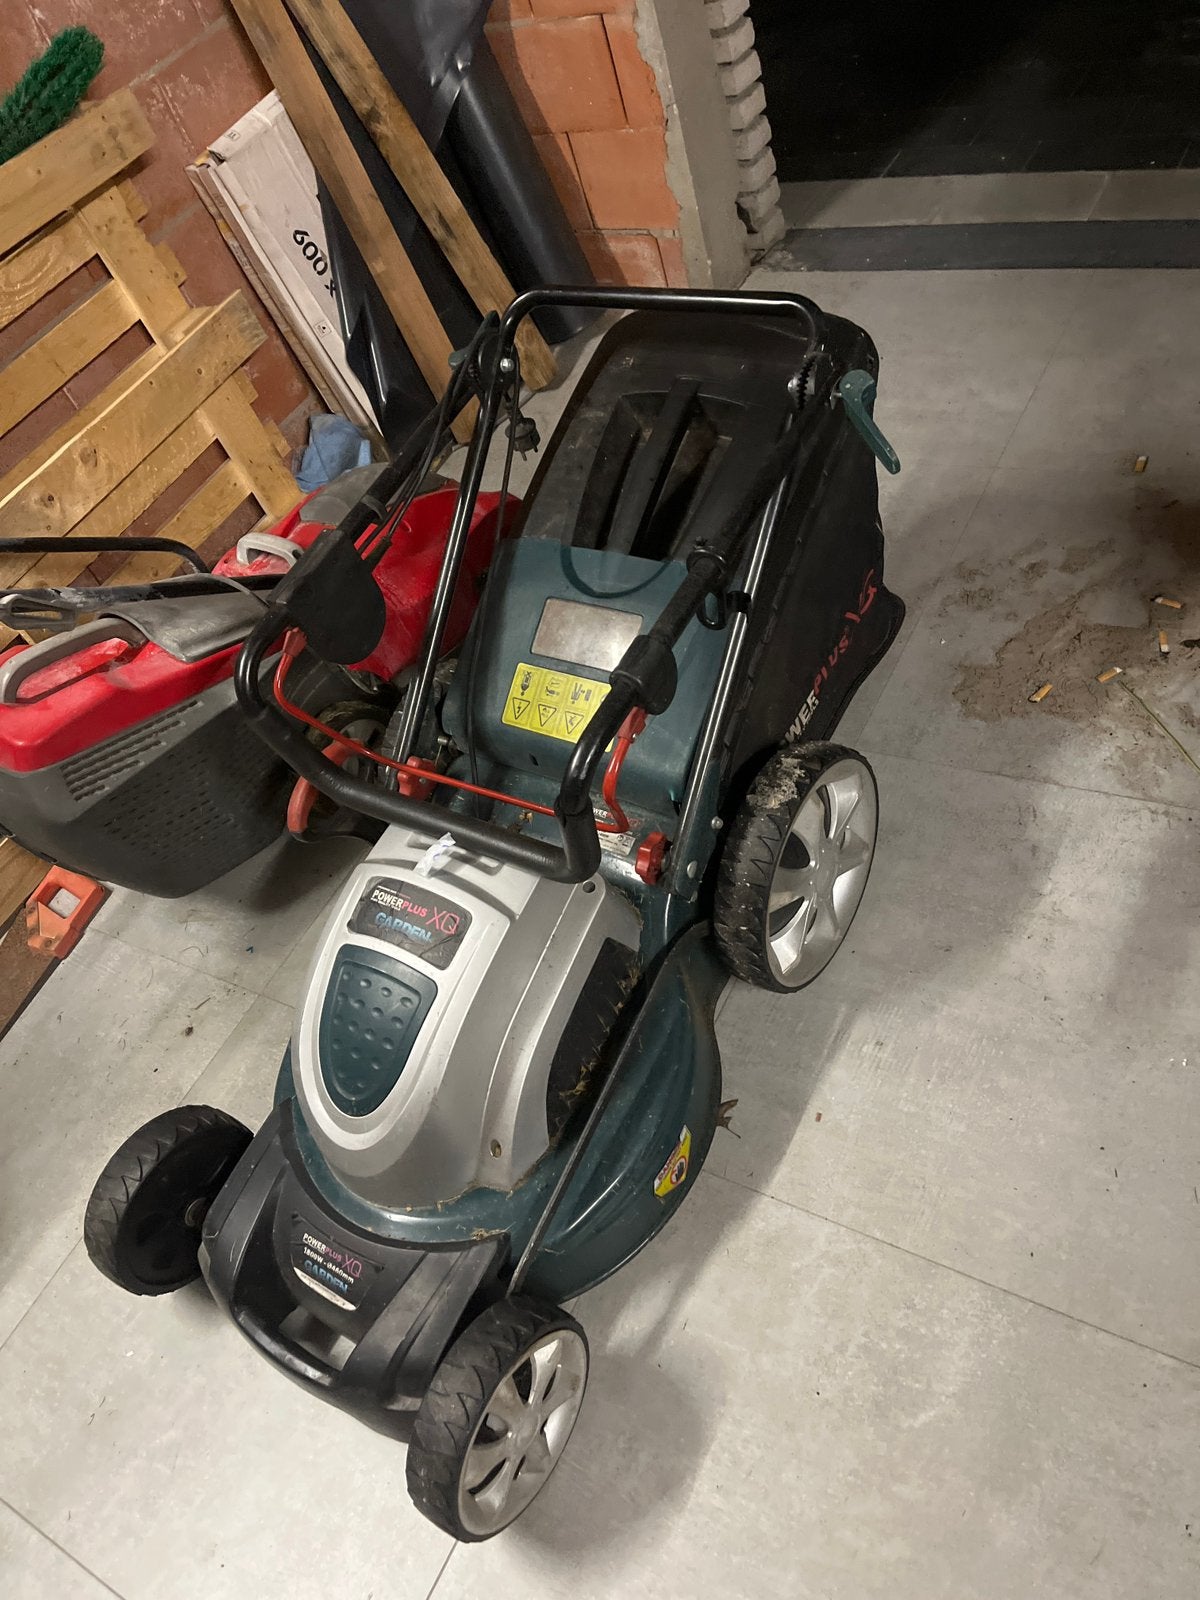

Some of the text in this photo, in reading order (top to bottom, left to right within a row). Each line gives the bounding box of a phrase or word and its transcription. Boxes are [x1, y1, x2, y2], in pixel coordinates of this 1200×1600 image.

[292, 228, 329, 277] 600
[371, 889, 428, 917] POWERPLUS
[425, 905, 460, 935] XQ
[374, 911, 432, 943] GARDEN
[303, 1247, 324, 1263] 1800W
[303, 1232, 342, 1262] POWERPLUS
[341, 1253, 362, 1279] XQ
[304, 1260, 348, 1292] GARDEN
